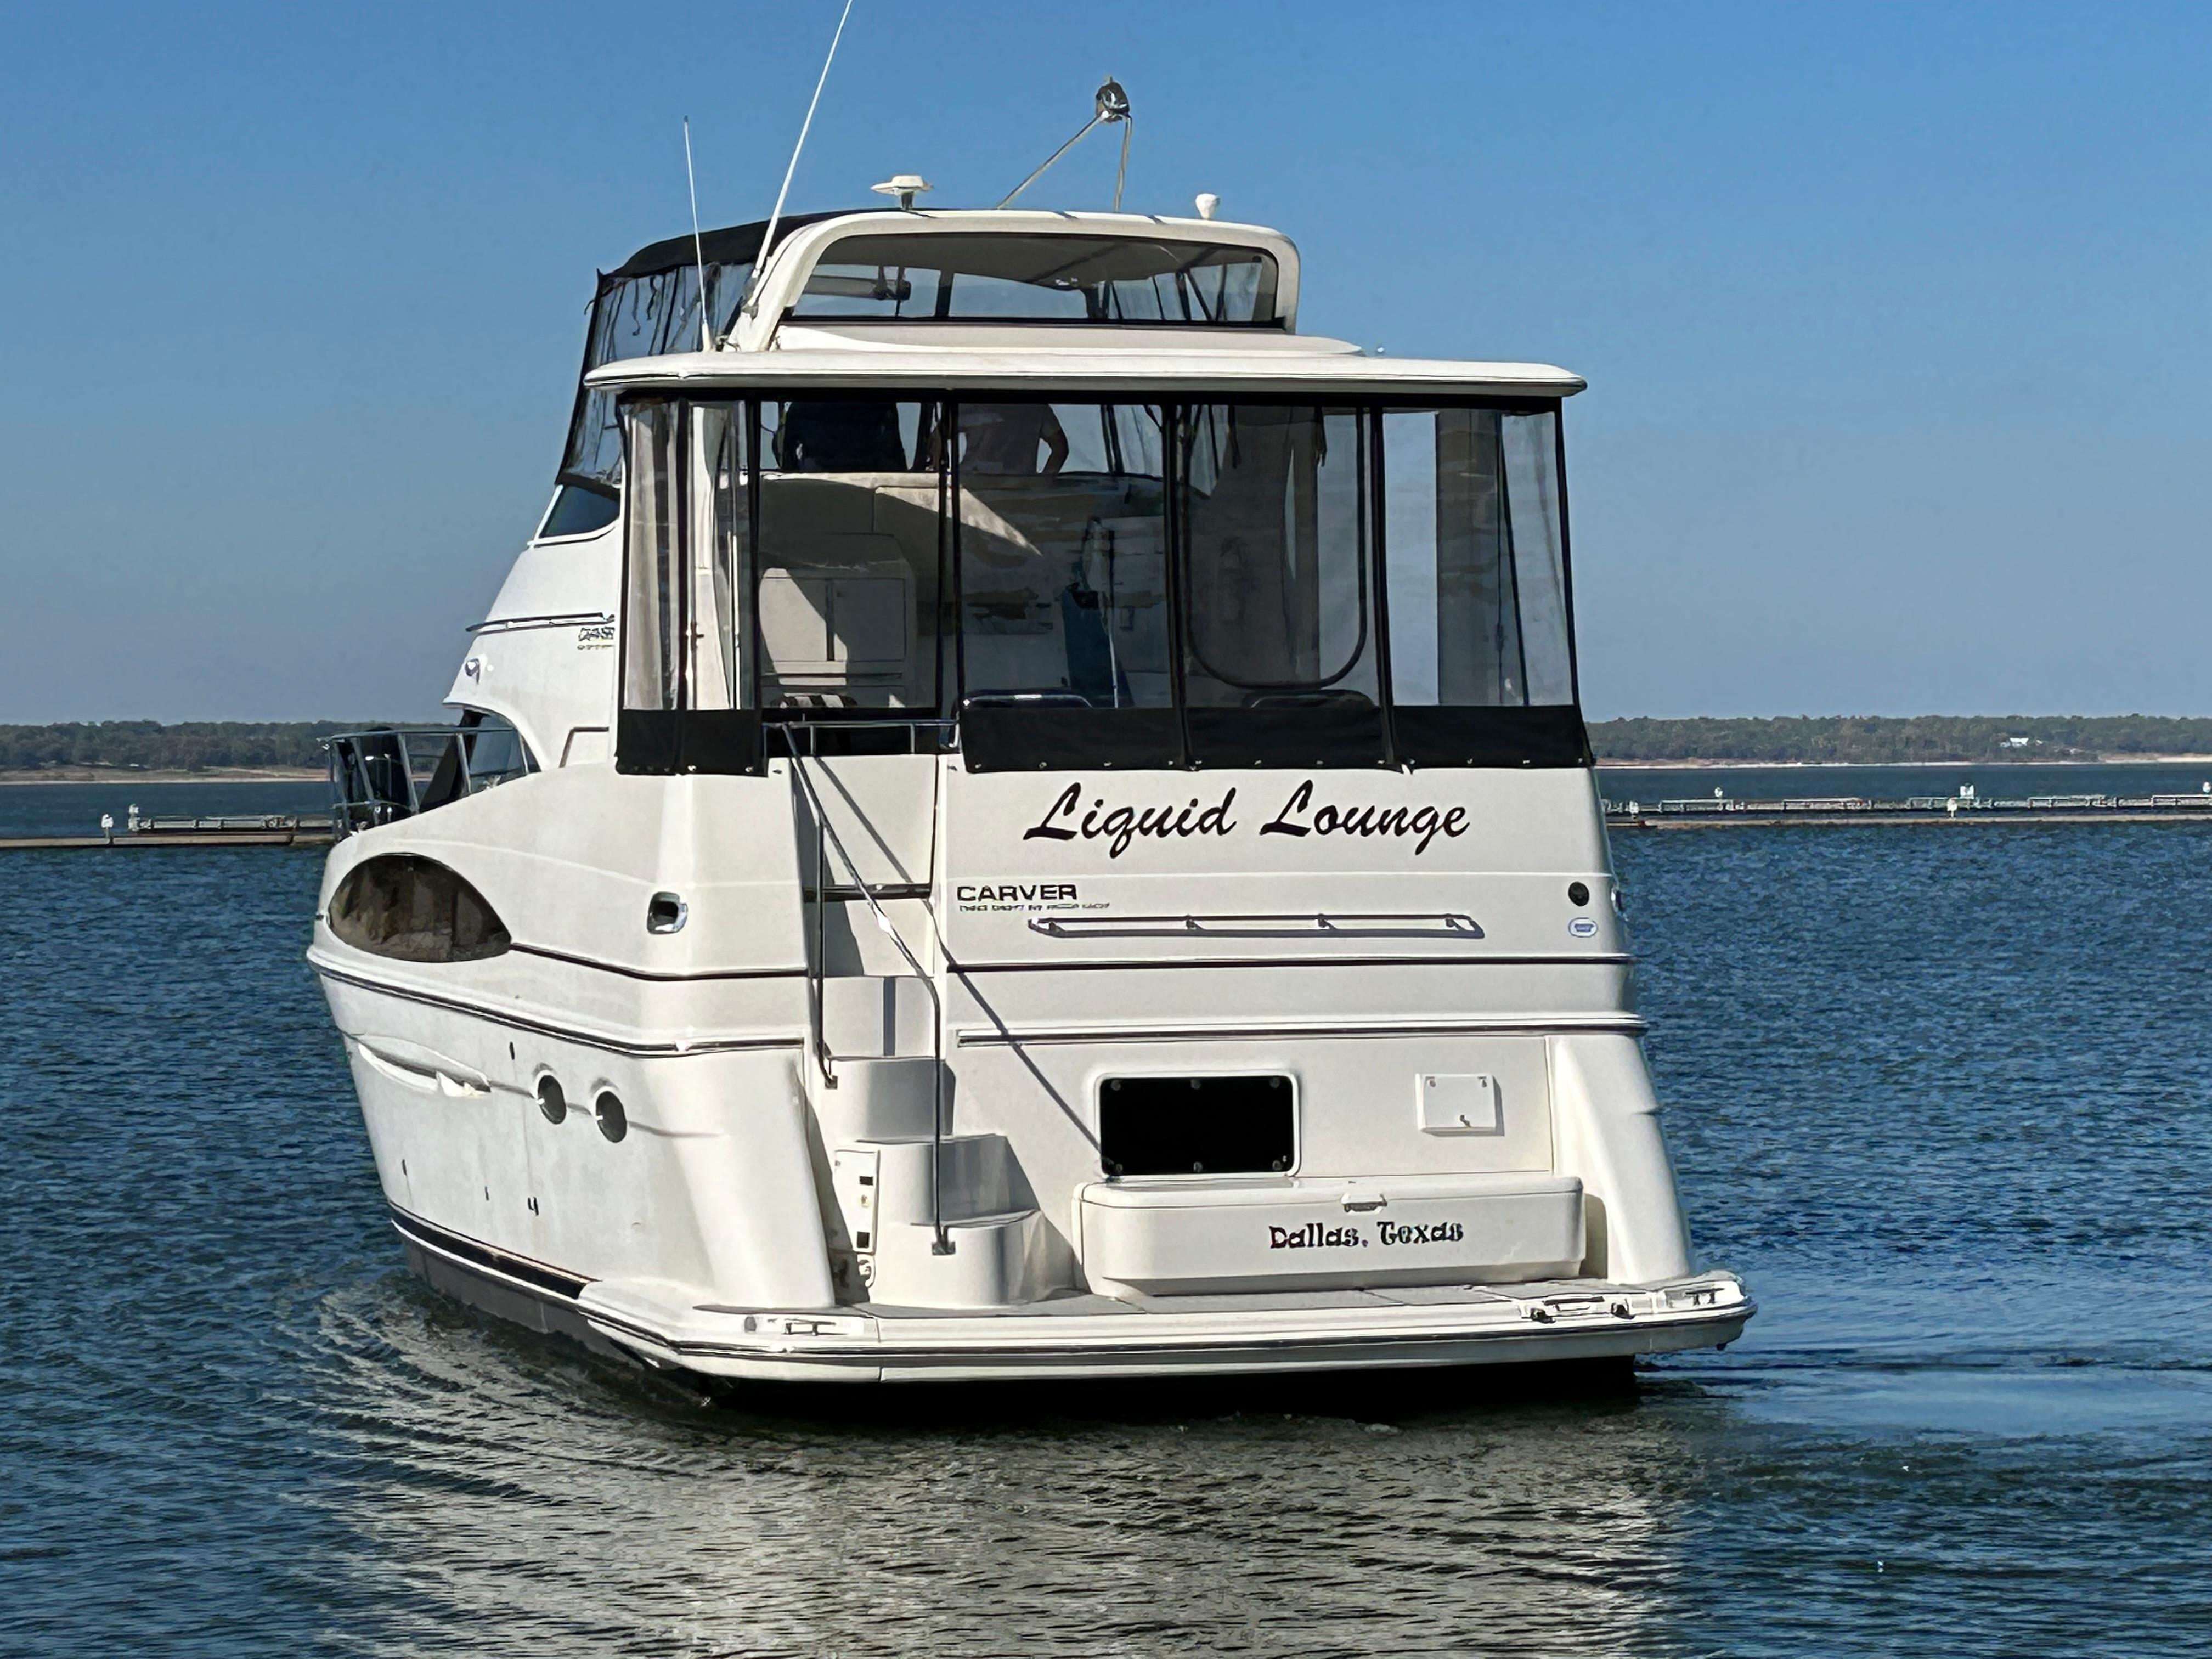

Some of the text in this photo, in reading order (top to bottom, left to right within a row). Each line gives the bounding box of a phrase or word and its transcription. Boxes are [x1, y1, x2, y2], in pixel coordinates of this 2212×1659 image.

[1023, 779, 1470, 859] Liquid Lounge
[956, 884, 1077, 901] CARVER
[1376, 1221, 1464, 1246] Texas
